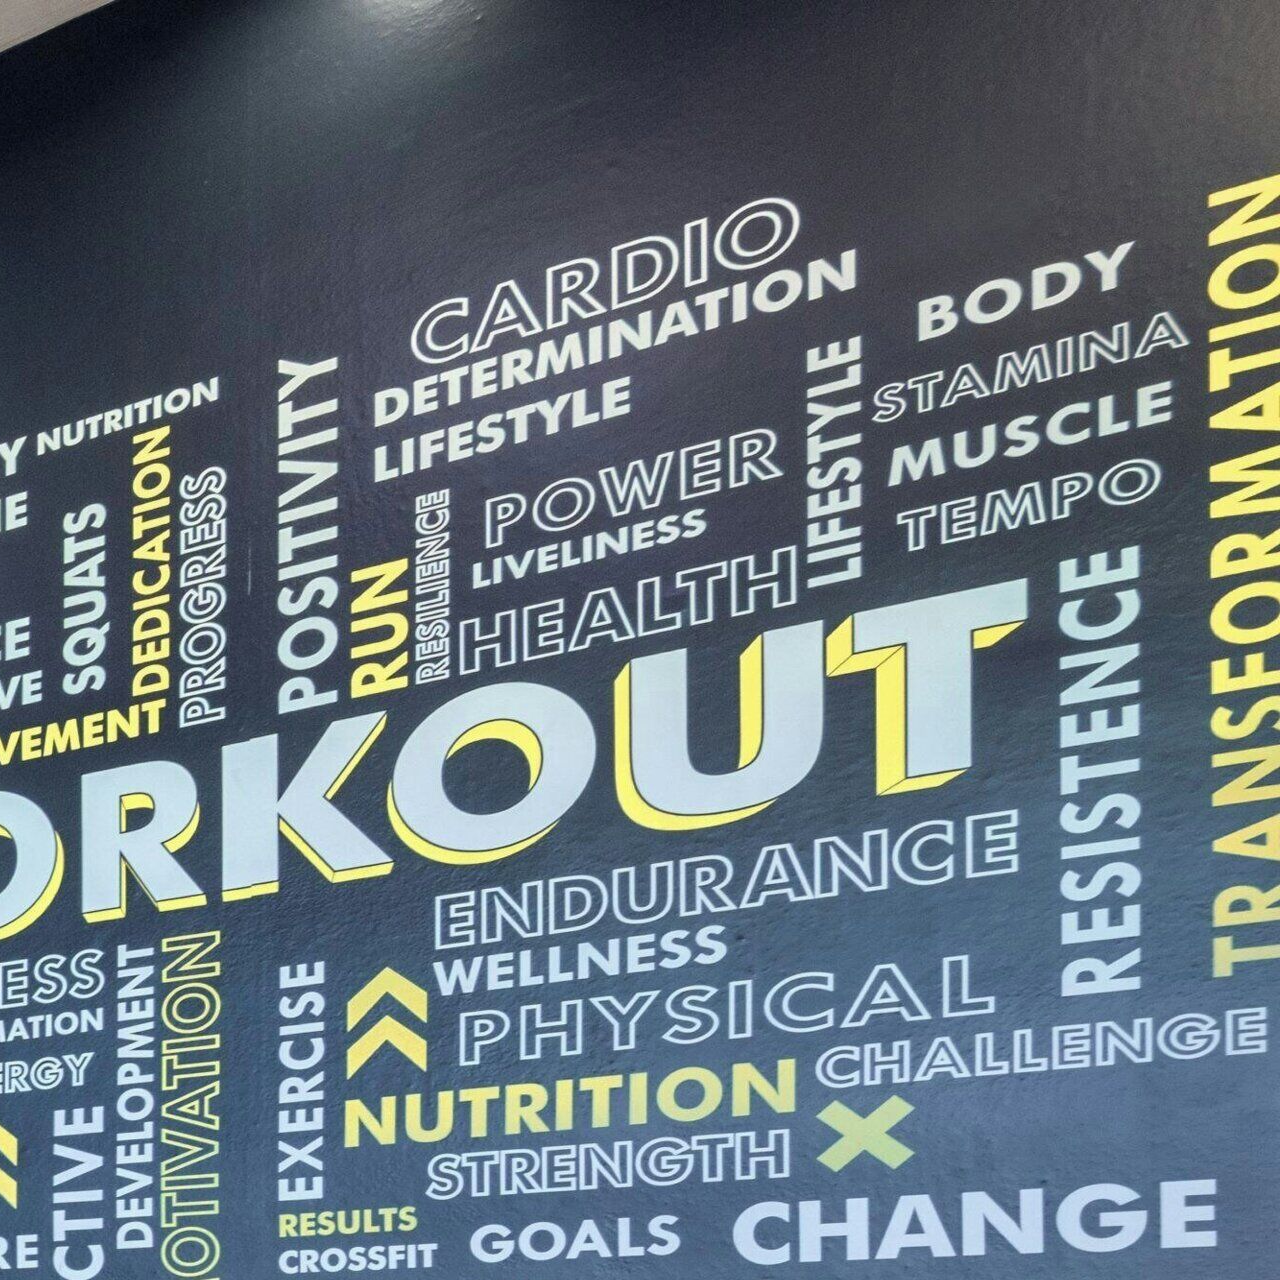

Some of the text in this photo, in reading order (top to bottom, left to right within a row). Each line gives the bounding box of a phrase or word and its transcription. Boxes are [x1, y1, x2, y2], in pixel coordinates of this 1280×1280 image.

[374, 248, 857, 428] DETERMINATION
[410, 197, 800, 365] CARDIO
[917, 241, 1135, 342] BODY
[36, 377, 220, 456] NUTRITION
[871, 311, 1190, 422] STAMINA
[374, 376, 631, 483] LIFESTYLE
[807, 335, 861, 588] LIFESTYLE
[888, 380, 1172, 488] MUSCLE
[277, 357, 338, 714] POSITIVITY
[485, 428, 783, 548] POWER
[896, 459, 1162, 552] TEMPO
[62, 502, 107, 695] SQUATS
[132, 426, 171, 698] DEDICATION
[179, 466, 227, 728] PROGRESS
[416, 488, 450, 685] RESILIENCE
[472, 509, 707, 589] LIVELINESS
[1209, 174, 1280, 977] TRANSFORMATION
[351, 558, 409, 700] RUN
[459, 546, 798, 676] HEALTH
[1059, 545, 1141, 997] RESISTENCE
[434, 809, 1019, 950] ENDURANCE
[433, 924, 728, 996] WELLNESS
[458, 954, 995, 1066] PHYSICAL
[116, 944, 155, 1249] DEVELOPMENT
[278, 960, 325, 1202] EXERCISE
[343, 1058, 797, 1148] NUTRITION
[815, 1006, 1268, 1089] CHALLENGE
[278, 1205, 418, 1238] RESULTS
[425, 1128, 790, 1201] STRENGTH
[732, 1178, 1218, 1266] CHANGE
[278, 1242, 438, 1275] CROSSFIT
[469, 1214, 681, 1263] GOALS
